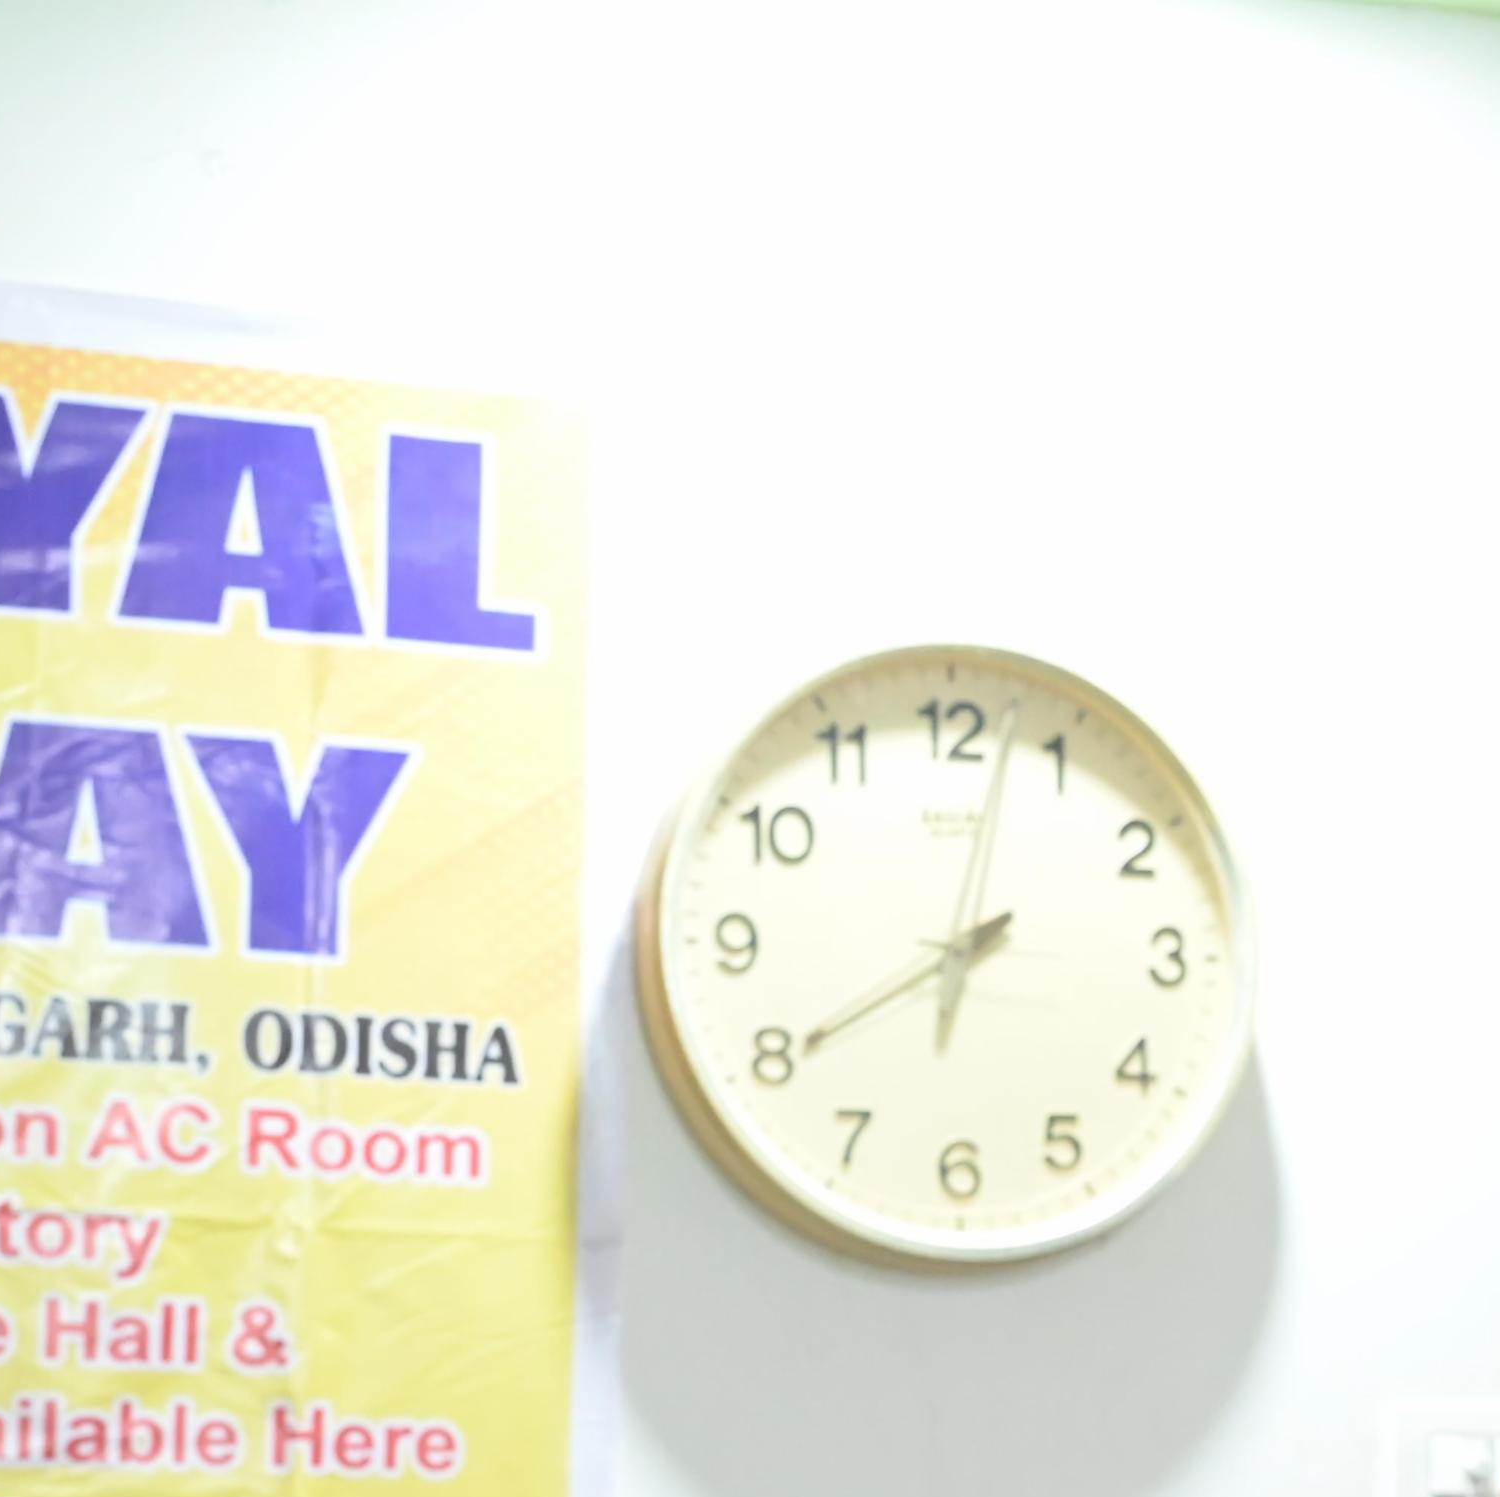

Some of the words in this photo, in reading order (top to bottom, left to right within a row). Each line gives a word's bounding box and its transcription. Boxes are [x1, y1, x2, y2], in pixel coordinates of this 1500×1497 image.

[814, 722, 867, 786] 11
[917, 700, 986, 763] 12
[1043, 733, 1066, 796] 1
[741, 805, 815, 866] 10
[1118, 820, 1156, 878] 2
[715, 912, 759, 974] 9
[1149, 927, 1186, 988] 3
[244, 1009, 519, 1085] ODISHA
[751, 1026, 795, 1086] 8
[1116, 1037, 1157, 1097] 4
[88, 1100, 213, 1166] AC
[245, 1108, 482, 1179] Room
[834, 1109, 872, 1168] 7
[1043, 1114, 1082, 1171] 5
[938, 1140, 981, 1199] 6
[43, 1298, 200, 1365] Hall
[232, 1305, 289, 1368] &
[272, 1405, 458, 1472] Here
